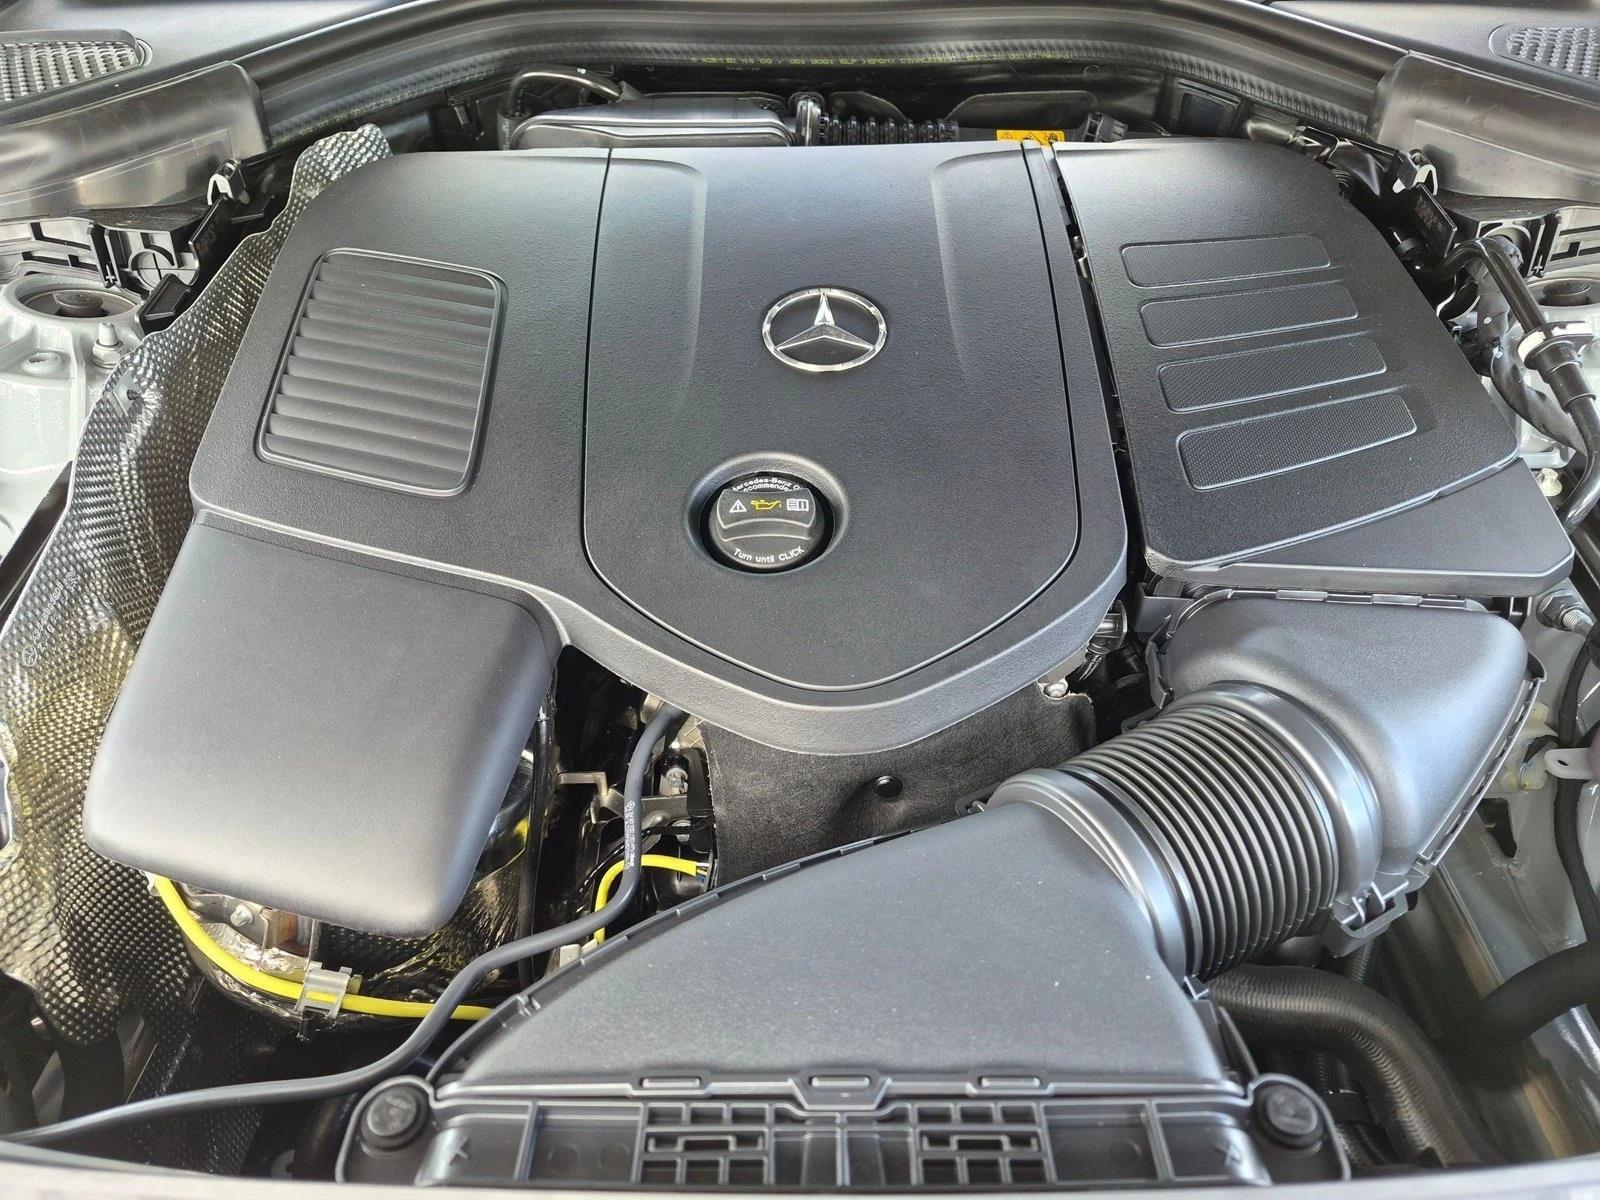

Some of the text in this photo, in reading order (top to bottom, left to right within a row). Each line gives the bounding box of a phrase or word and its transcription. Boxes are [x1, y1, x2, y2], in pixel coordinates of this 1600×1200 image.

[733, 546, 805, 563] Turn until CLICK
